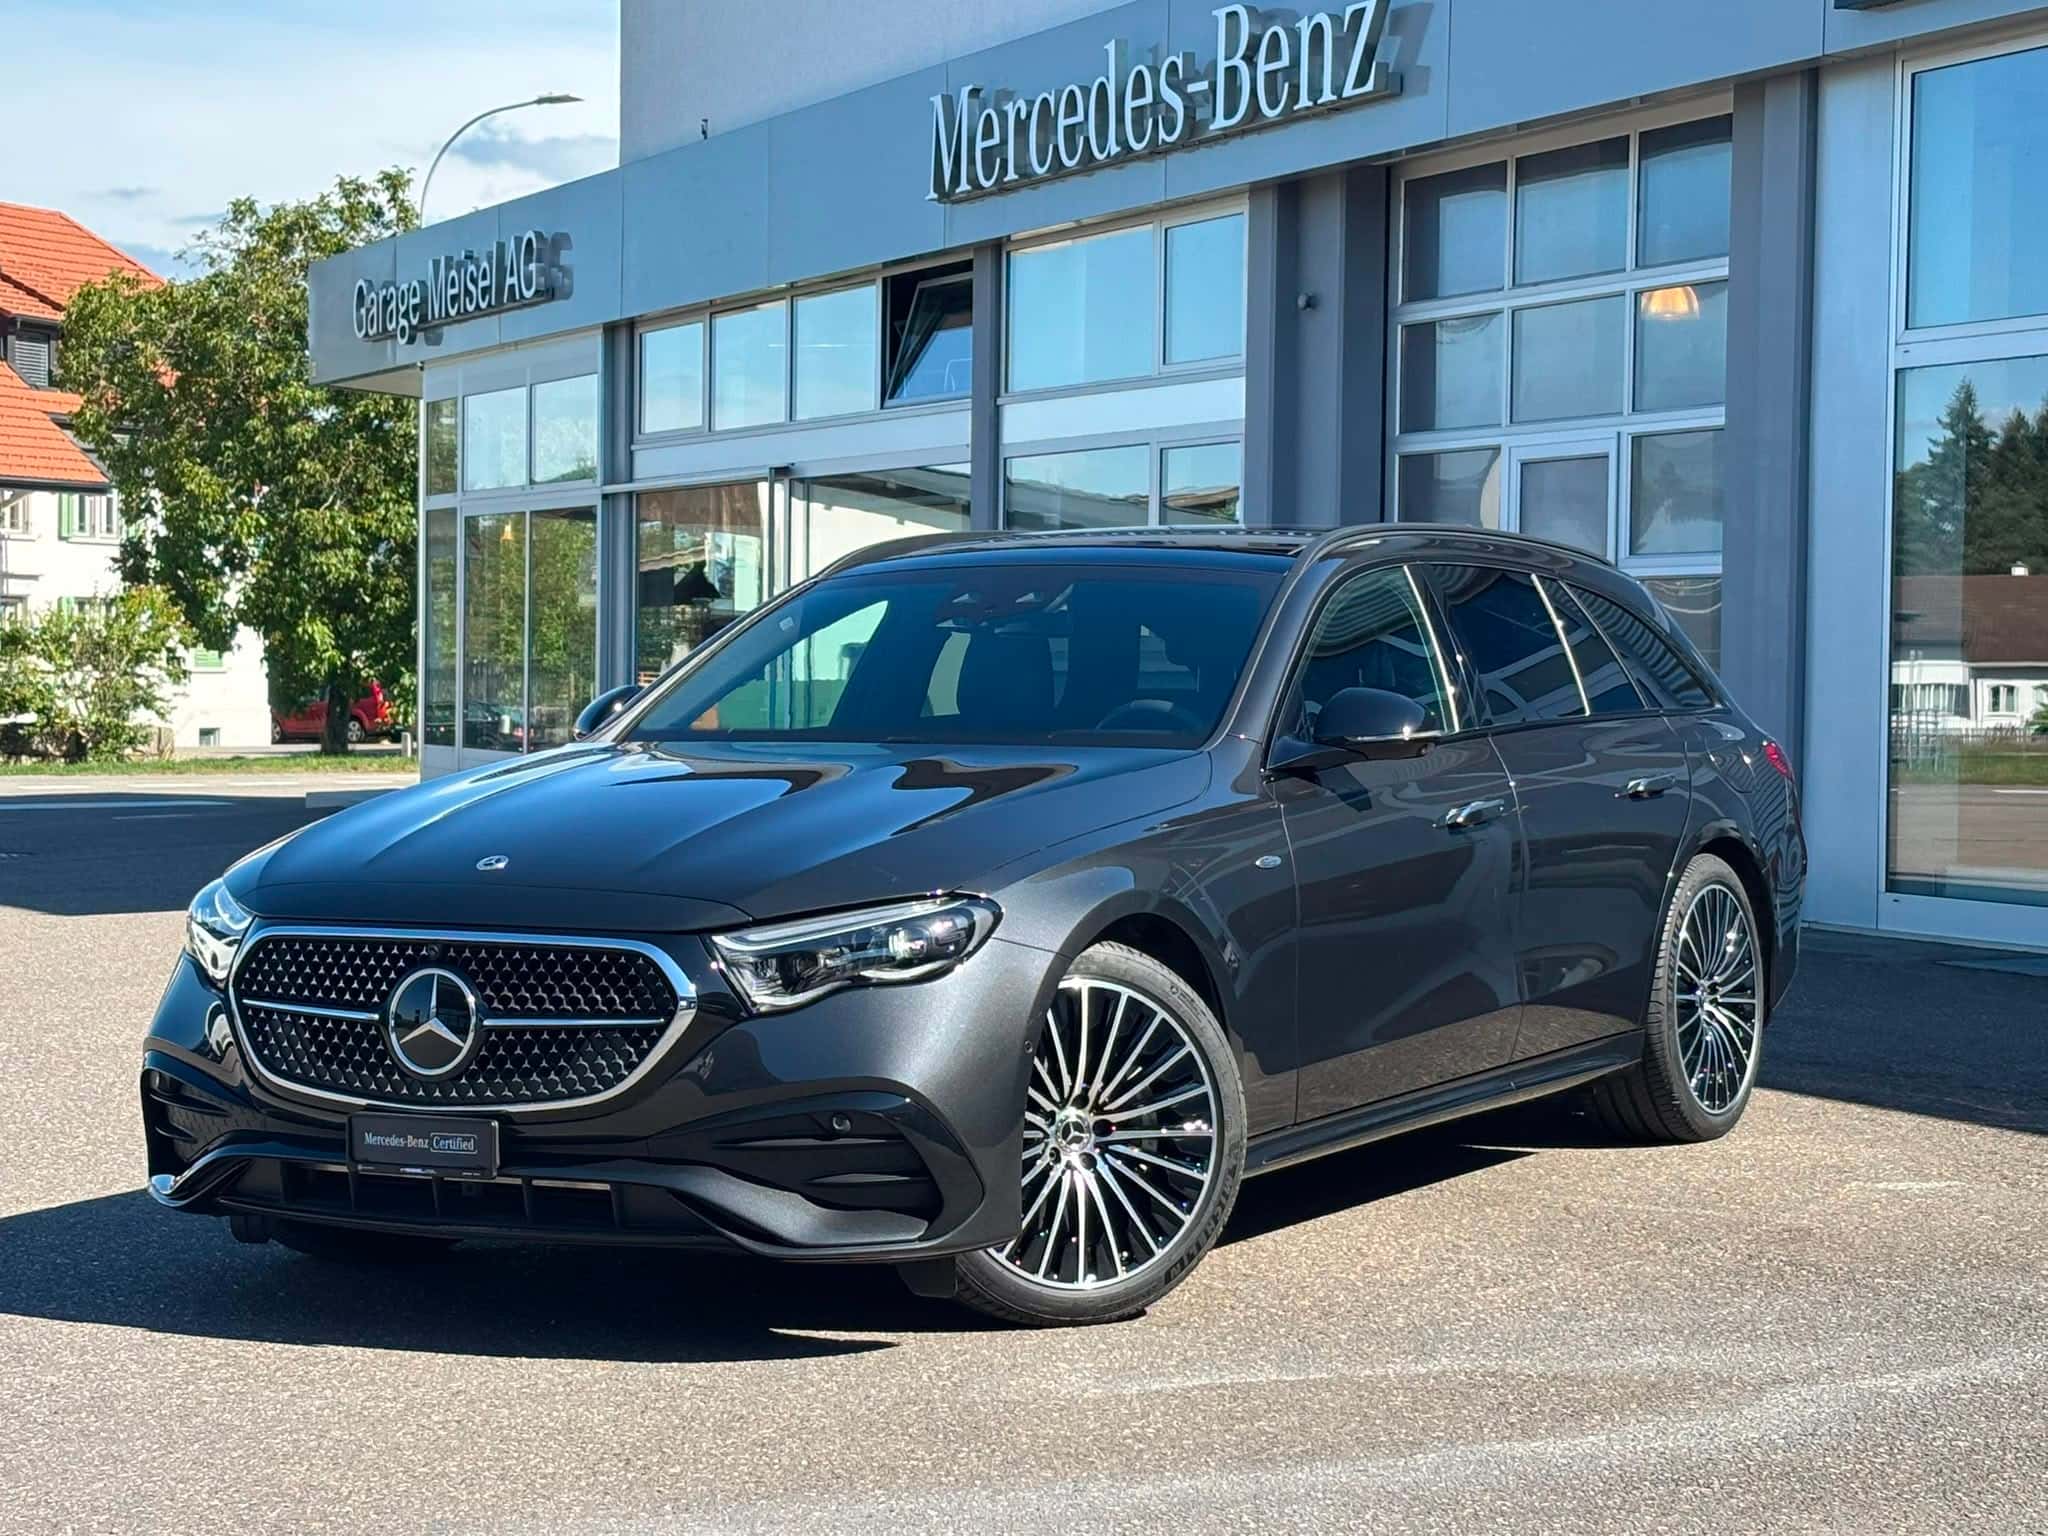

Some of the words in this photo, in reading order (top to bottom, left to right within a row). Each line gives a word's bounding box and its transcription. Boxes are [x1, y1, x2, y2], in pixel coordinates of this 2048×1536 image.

[926, 0, 1378, 200] Mercedes-Benz
[353, 279, 420, 345] Garage
[428, 241, 497, 320] Meisel
[504, 230, 537, 303] AG
[364, 1132, 429, 1149] Mercedes-Benz
[433, 1136, 475, 1151] Certified
